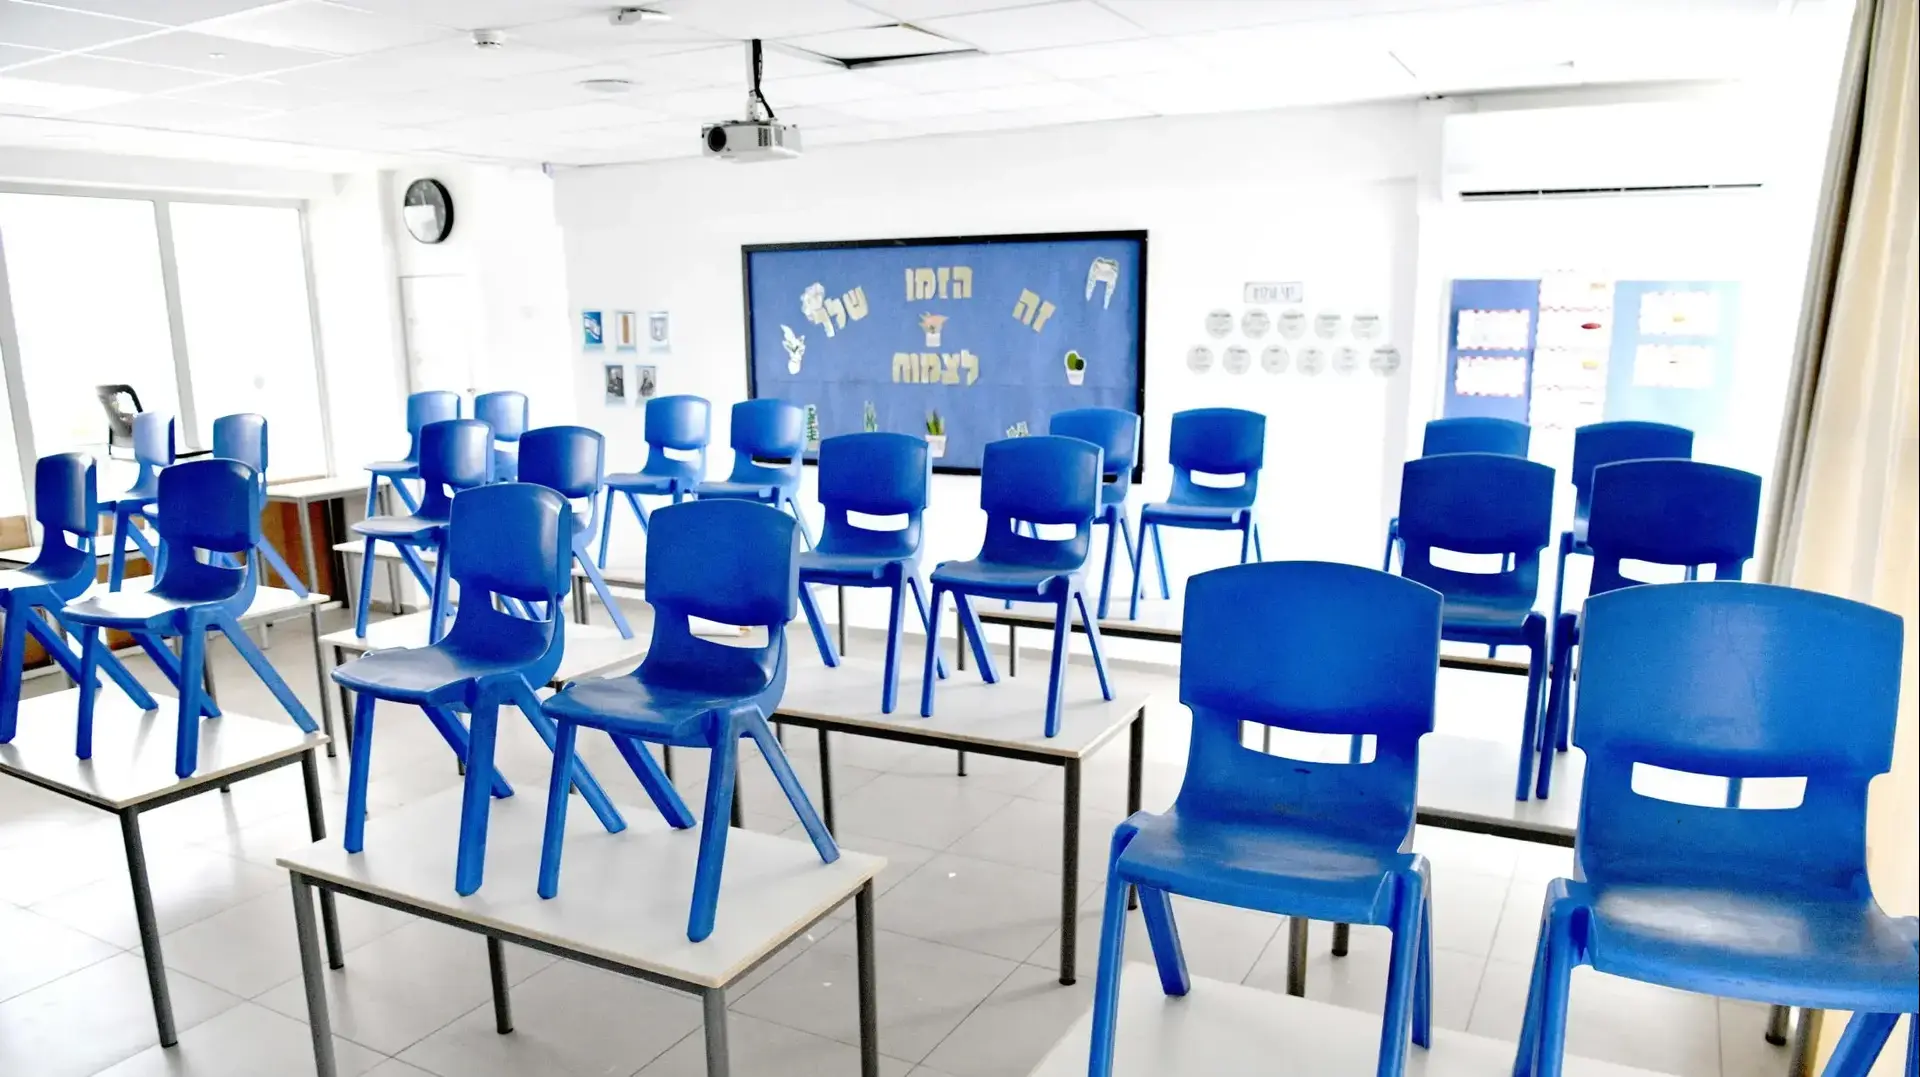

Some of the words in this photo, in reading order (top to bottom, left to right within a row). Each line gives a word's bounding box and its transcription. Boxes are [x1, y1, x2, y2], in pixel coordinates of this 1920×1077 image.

[905, 266, 973, 301] הזמן
[811, 286, 868, 338] שלך
[1012, 288, 1056, 333] זה
[892, 349, 979, 385] לצמוח
